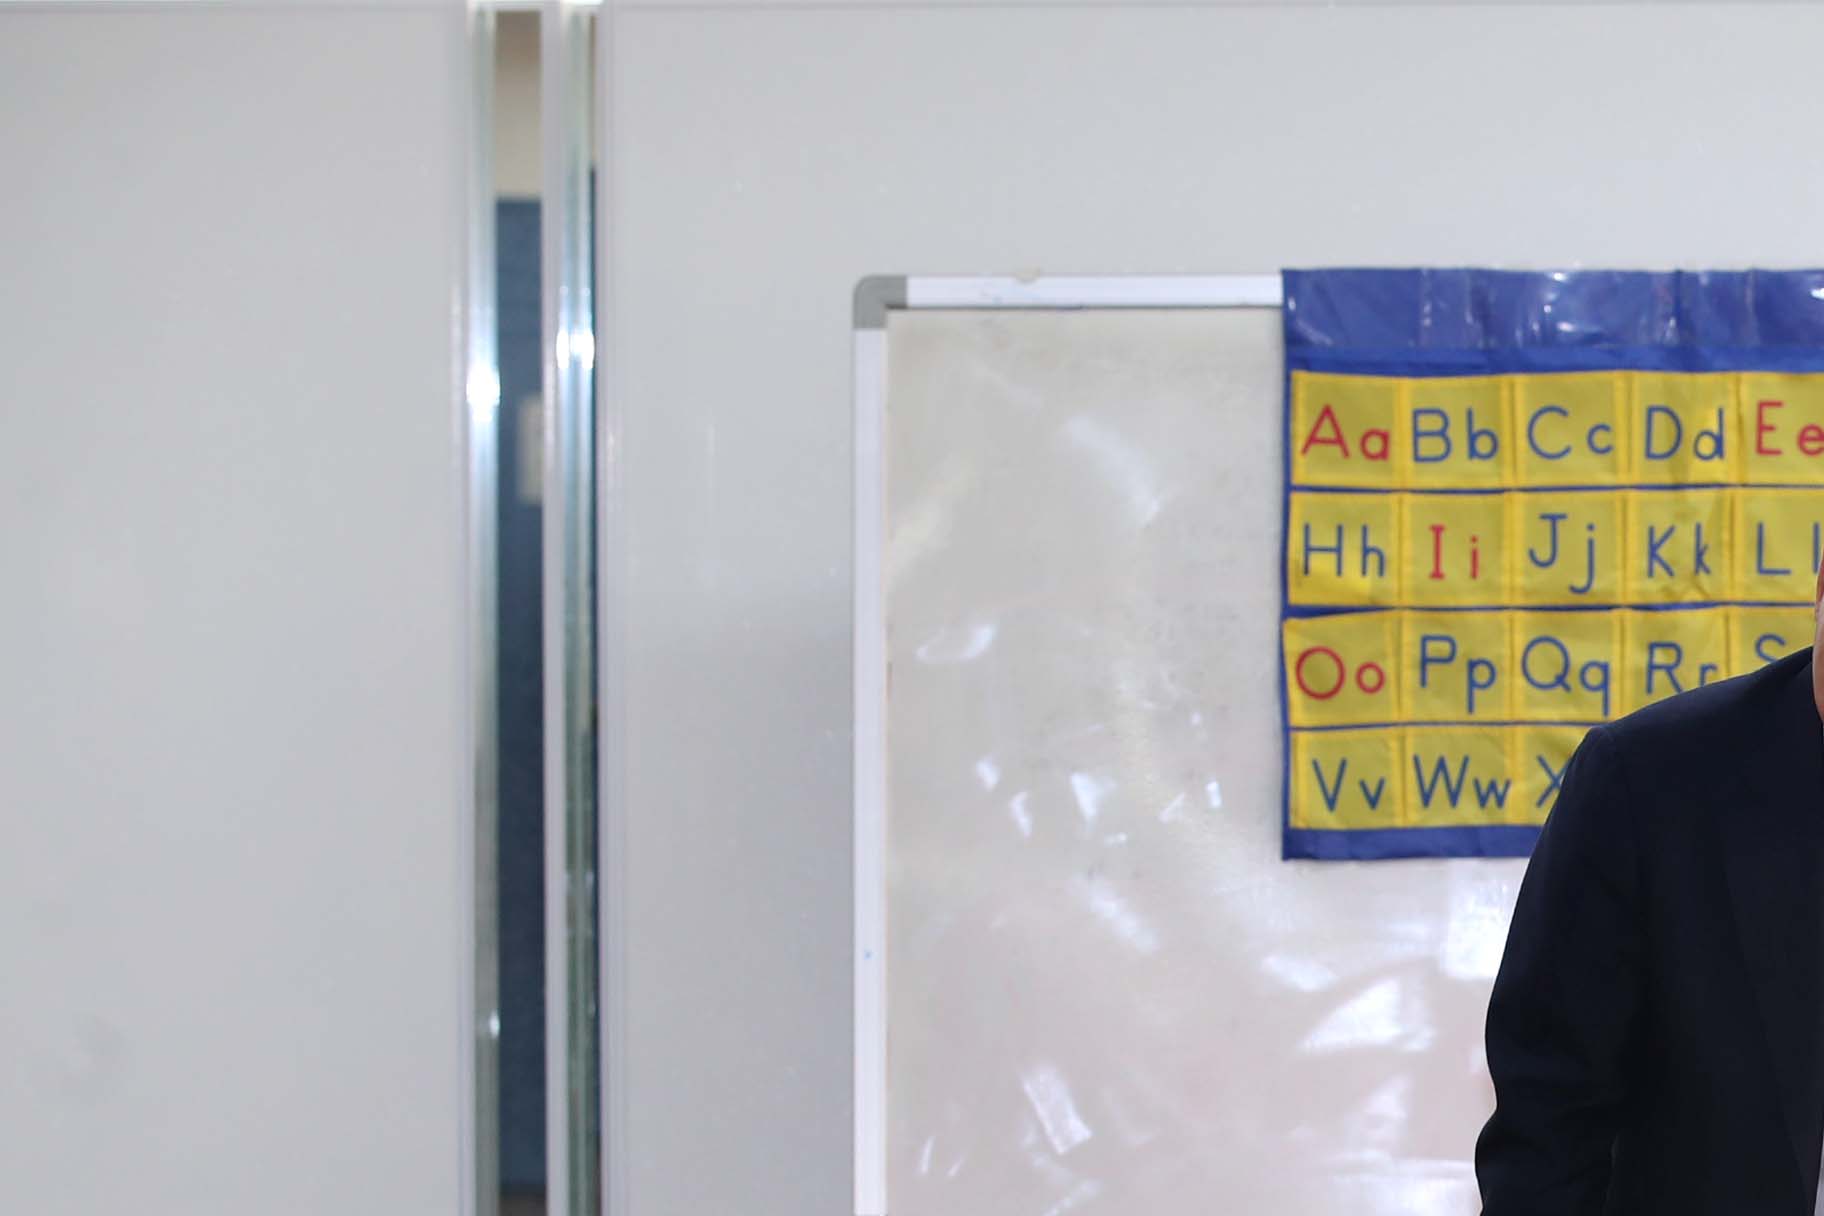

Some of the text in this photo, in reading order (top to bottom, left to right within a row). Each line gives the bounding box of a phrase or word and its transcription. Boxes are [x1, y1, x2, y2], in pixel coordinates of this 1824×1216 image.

[1301, 403, 1390, 461] Aa
[1412, 406, 1499, 463] Bb
[1527, 404, 1614, 460] Cc
[1644, 404, 1725, 461] Dd
[1303, 522, 1385, 578] Hh
[1429, 523, 1480, 580] Ii
[1528, 512, 1596, 594] Jj
[1647, 522, 1711, 578] Kk
[1295, 645, 1386, 701] Oo
[1419, 634, 1497, 715] Pp
[1521, 634, 1611, 717] Qq
[1312, 757, 1386, 812] Vv
[1413, 754, 1512, 809] Ww
